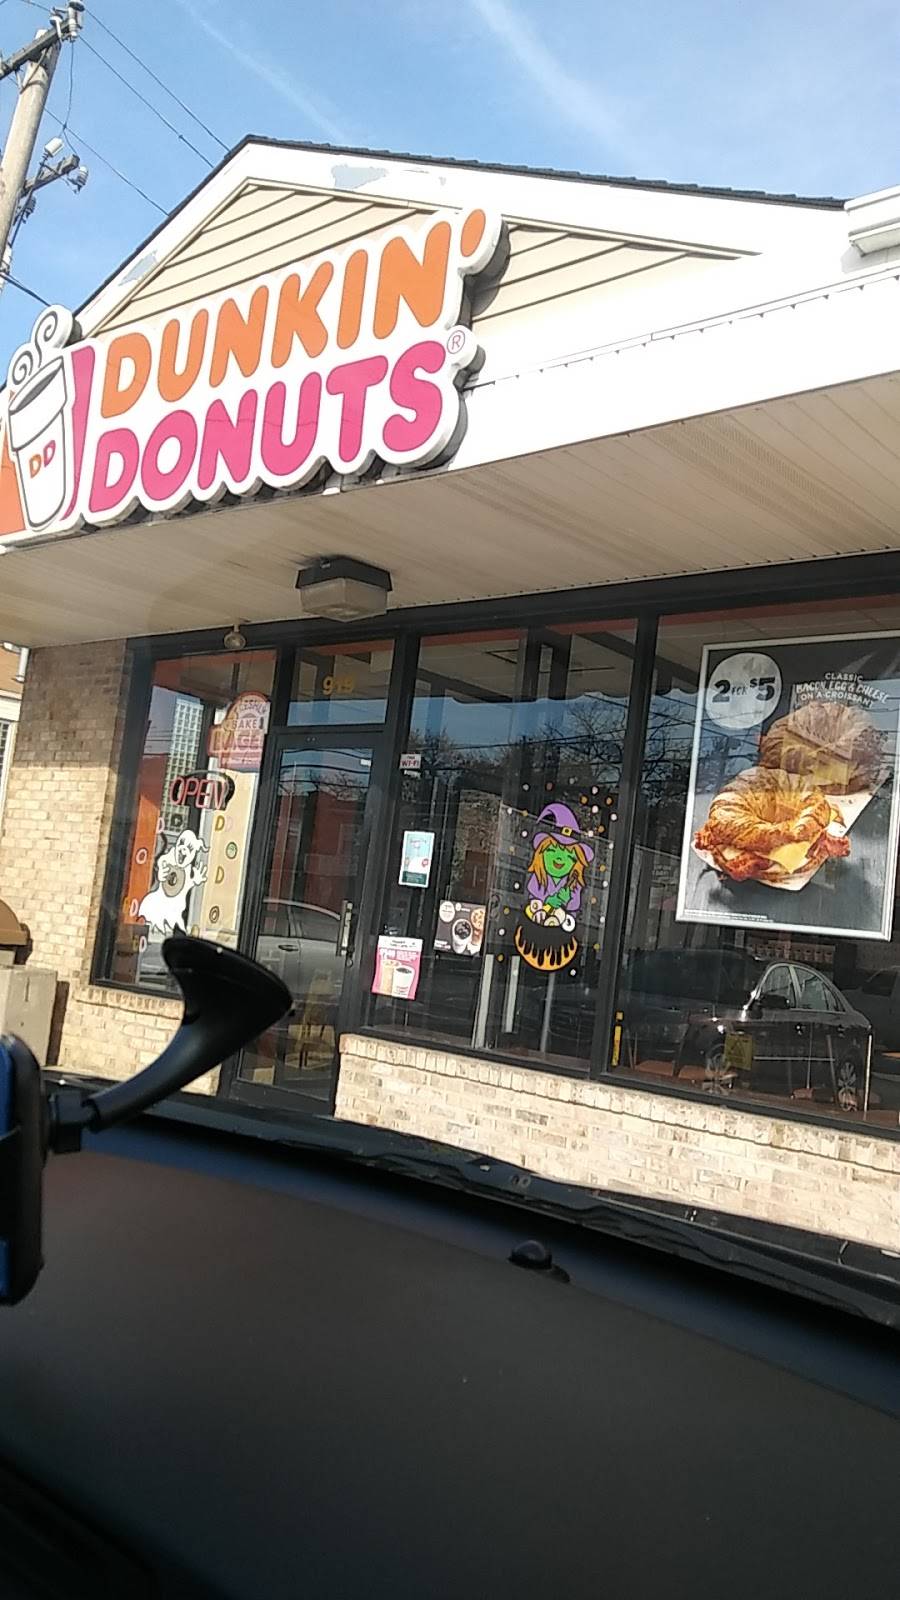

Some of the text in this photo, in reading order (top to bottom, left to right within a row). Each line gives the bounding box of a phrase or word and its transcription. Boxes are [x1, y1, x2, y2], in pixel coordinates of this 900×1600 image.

[101, 209, 486, 418] DUNKIN'
[88, 340, 446, 513] DONUTS
[712, 679, 731, 703] 2
[750, 677, 776, 702] $5
[825, 672, 863, 682] CLASSIC
[801, 692, 813, 701] ON
[824, 691, 874, 709] CROISSANT
[829, 681, 847, 691] EGG
[856, 684, 890, 704] CHEESE
[170, 776, 225, 809] OPEN
